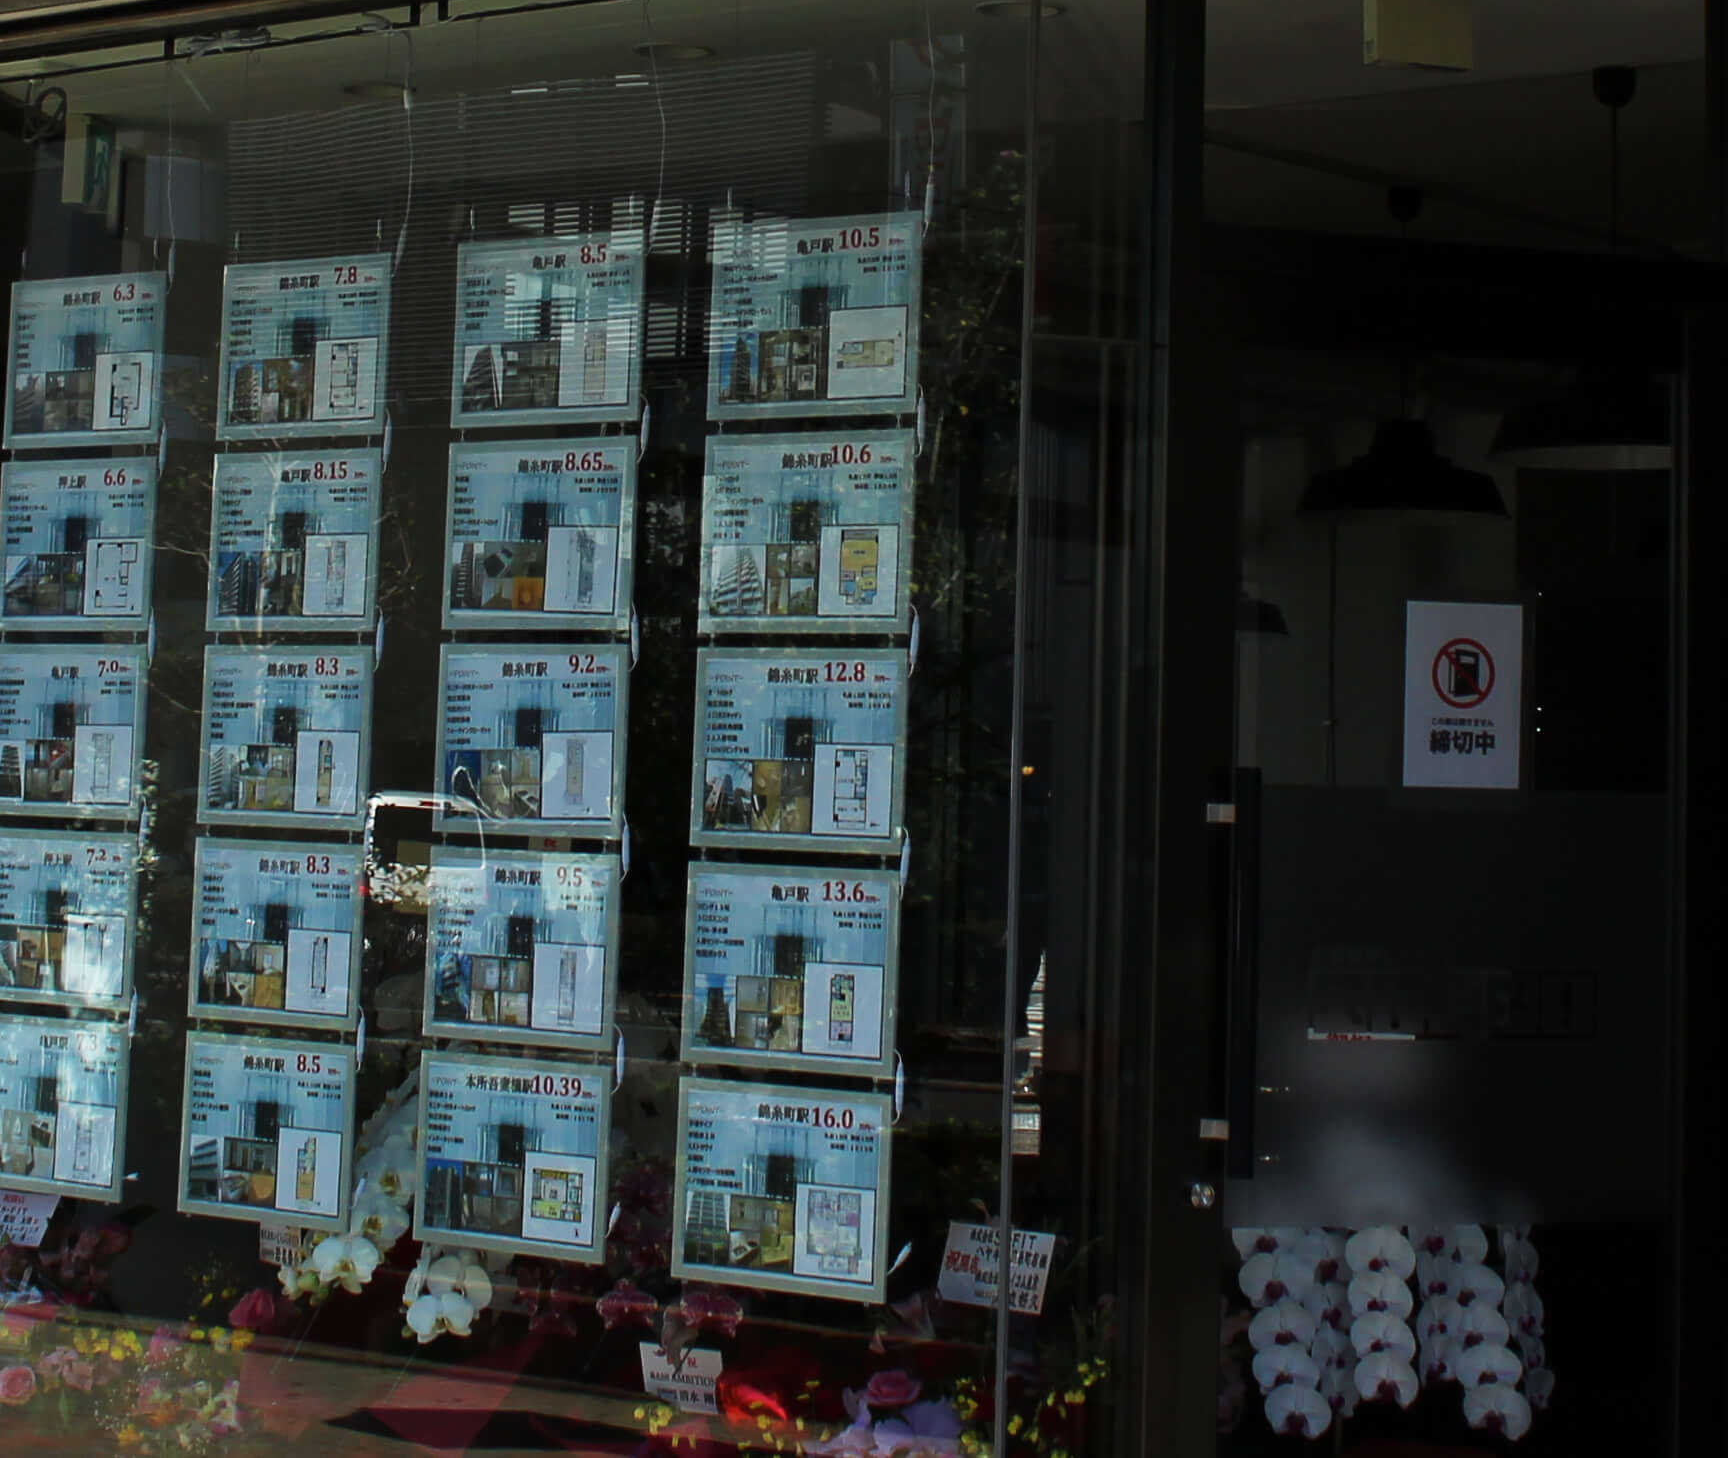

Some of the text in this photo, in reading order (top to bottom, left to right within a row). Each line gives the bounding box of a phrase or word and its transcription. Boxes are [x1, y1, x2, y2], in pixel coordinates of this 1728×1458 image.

[839, 227, 880, 250] 10.5
[580, 243, 608, 264] 8.5
[333, 266, 358, 285] 7.8
[113, 284, 136, 302] 6.3
[565, 451, 604, 471] 8.65
[831, 444, 872, 465] 10.6
[104, 469, 127, 487] 6.6
[314, 461, 348, 480] 8.15
[97, 659, 120, 676] 7.0
[315, 658, 339, 677] 8.3
[568, 654, 595, 674] 9.2
[823, 662, 866, 682] 12.8
[1429, 729, 1496, 756] 締切中
[86, 848, 107, 866] 7.2
[306, 855, 330, 875] 8.3
[557, 866, 583, 887] 9.5
[823, 880, 865, 903] 13.6
[296, 1053, 321, 1074] 8.5
[531, 1074, 583, 1098] 10.39
[811, 1107, 854, 1130] 16.0
